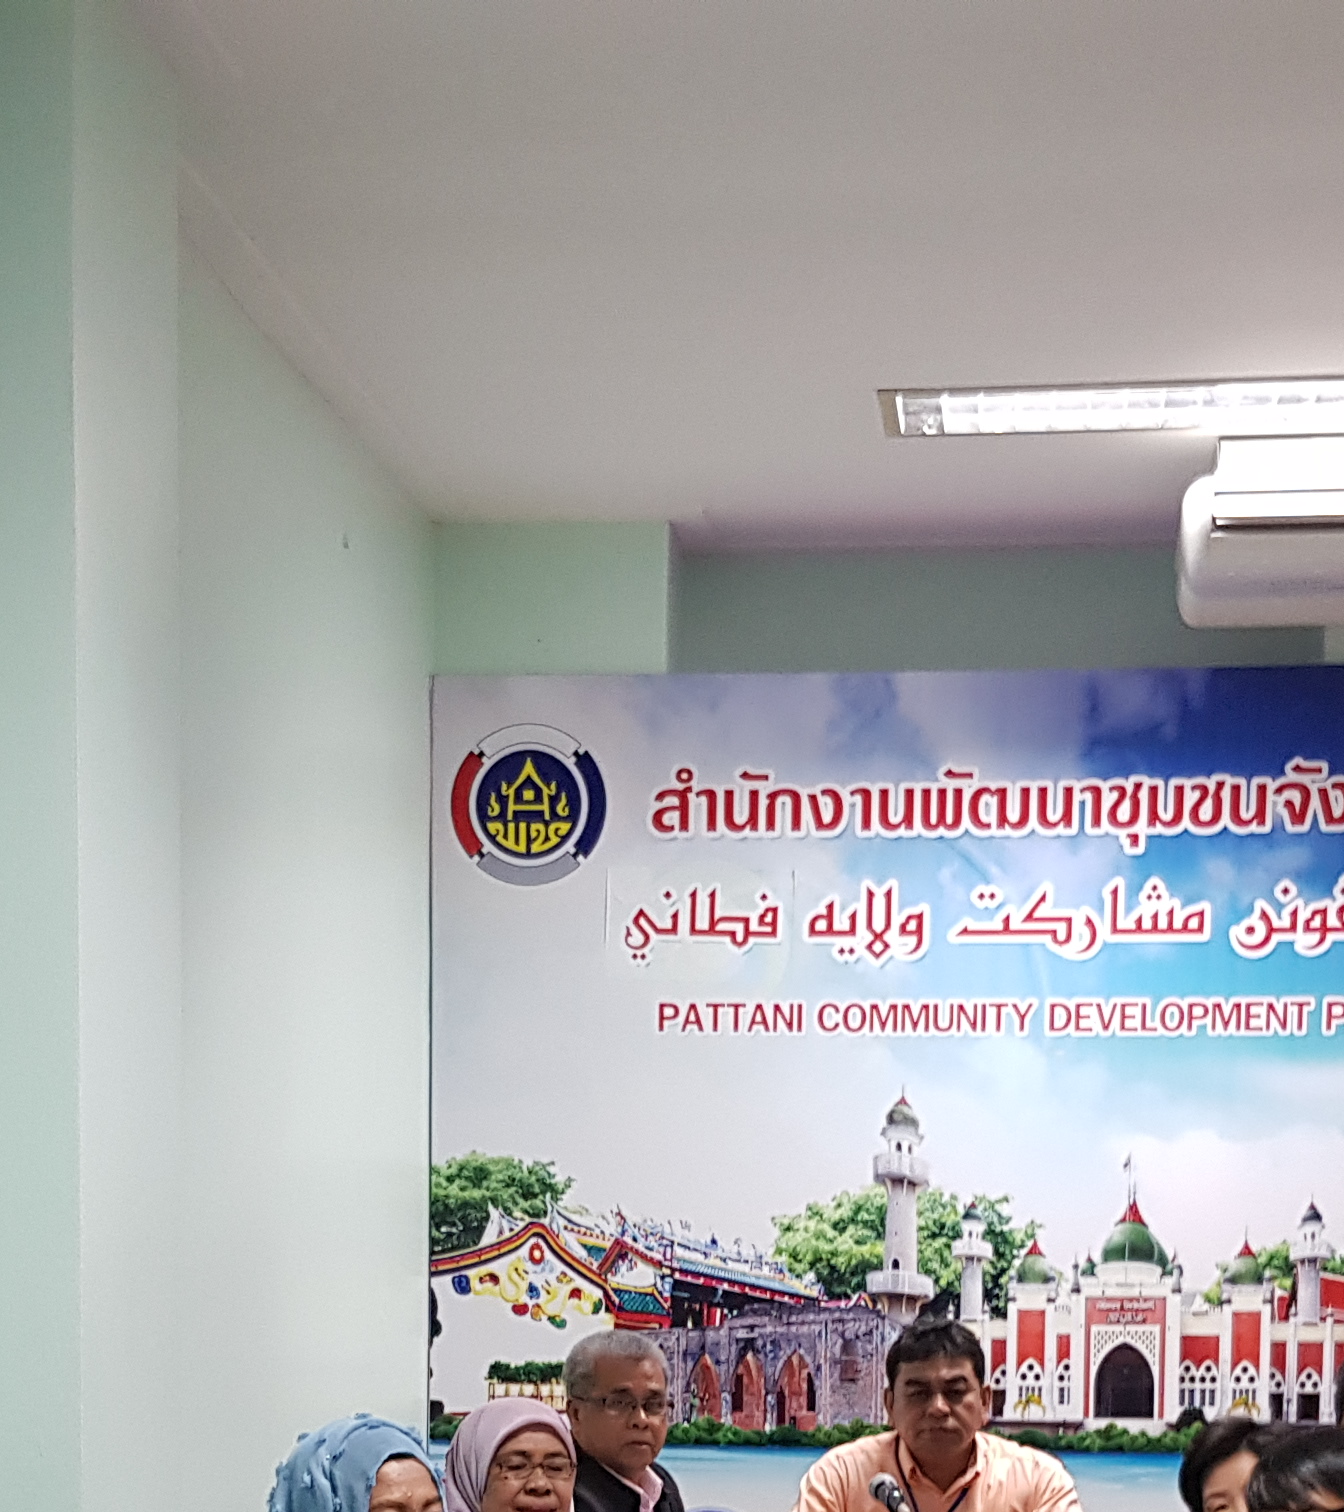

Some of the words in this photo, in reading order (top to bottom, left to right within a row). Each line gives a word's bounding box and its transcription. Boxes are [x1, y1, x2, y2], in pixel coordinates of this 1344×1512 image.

[657, 1001, 805, 1033] PATTANI
[816, 1001, 1034, 1034] COMMUNITY
[1048, 1000, 1311, 1034] DEVELOPMENT
